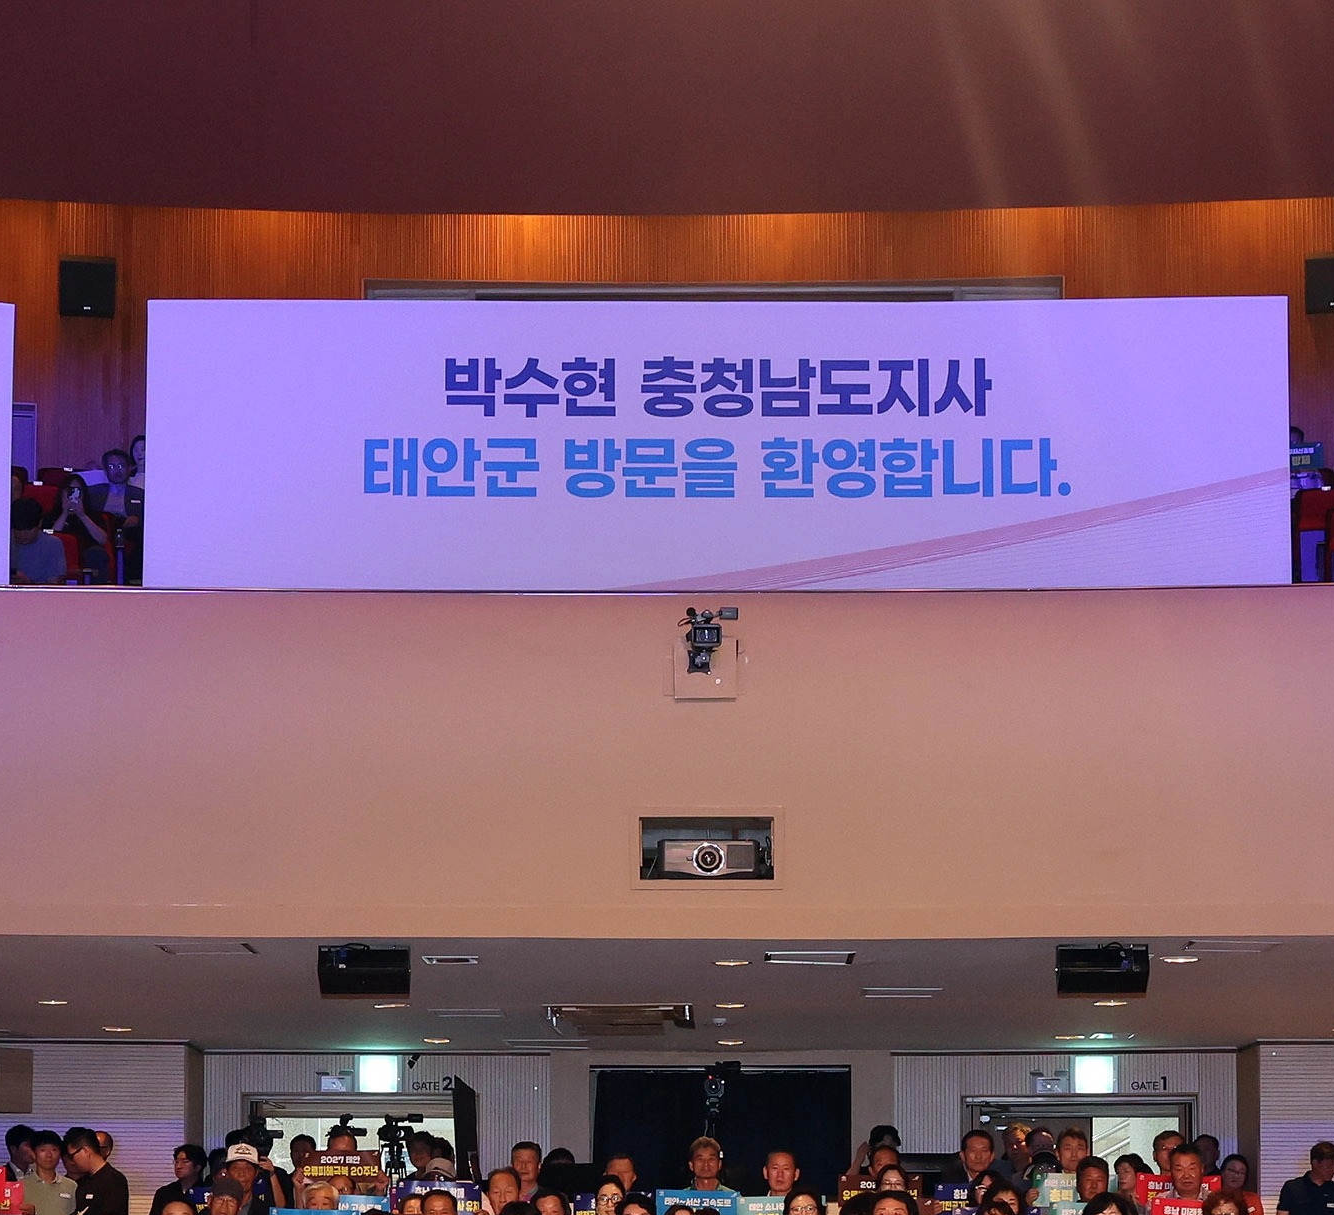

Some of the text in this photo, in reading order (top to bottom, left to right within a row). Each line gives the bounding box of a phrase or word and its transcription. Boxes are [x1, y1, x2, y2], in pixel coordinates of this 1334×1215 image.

[444, 356, 992, 420] 박수현 충청남도지사
[363, 437, 1071, 499] 태안군 방문을 환영합니다.
[412, 1077, 453, 1090] GATE 2
[1131, 1076, 1166, 1090] GATE 1
[320, 1155, 361, 1164] 2027 태안
[351, 1165, 378, 1176] 20주년
